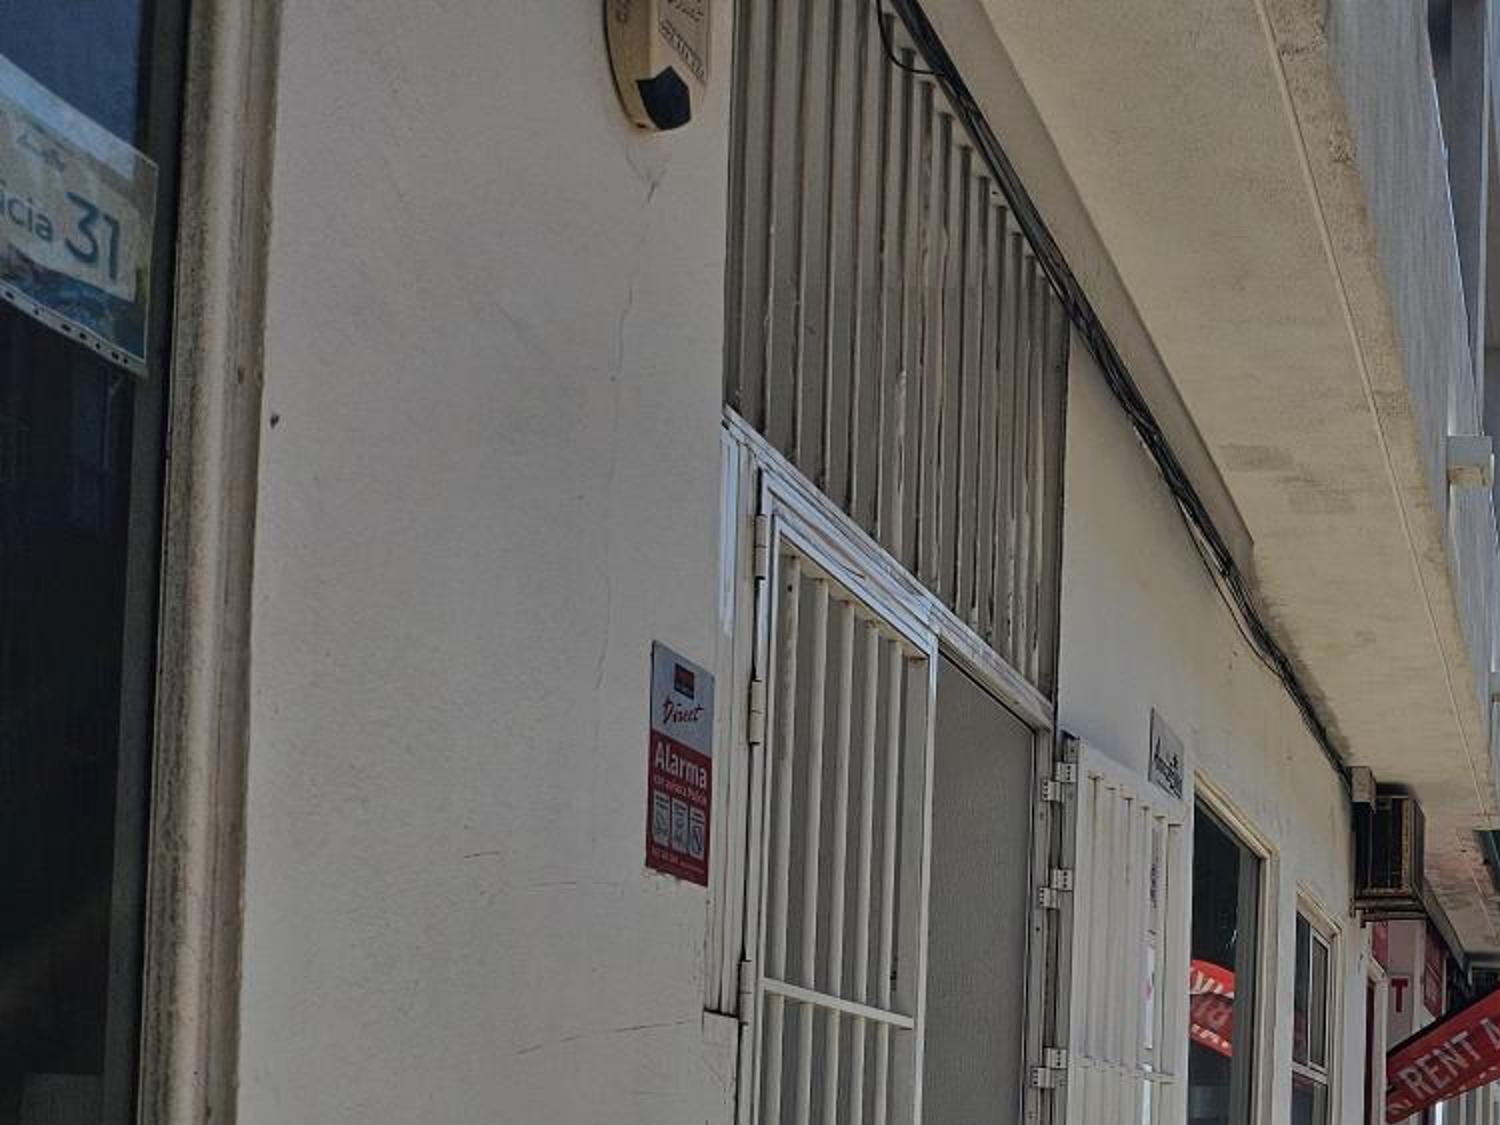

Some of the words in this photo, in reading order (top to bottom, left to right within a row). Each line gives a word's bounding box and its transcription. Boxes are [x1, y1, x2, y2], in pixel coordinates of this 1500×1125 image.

[64, 191, 120, 281] 31
[655, 741, 707, 789] Alarma
[1397, 1031, 1481, 1099] RENT
